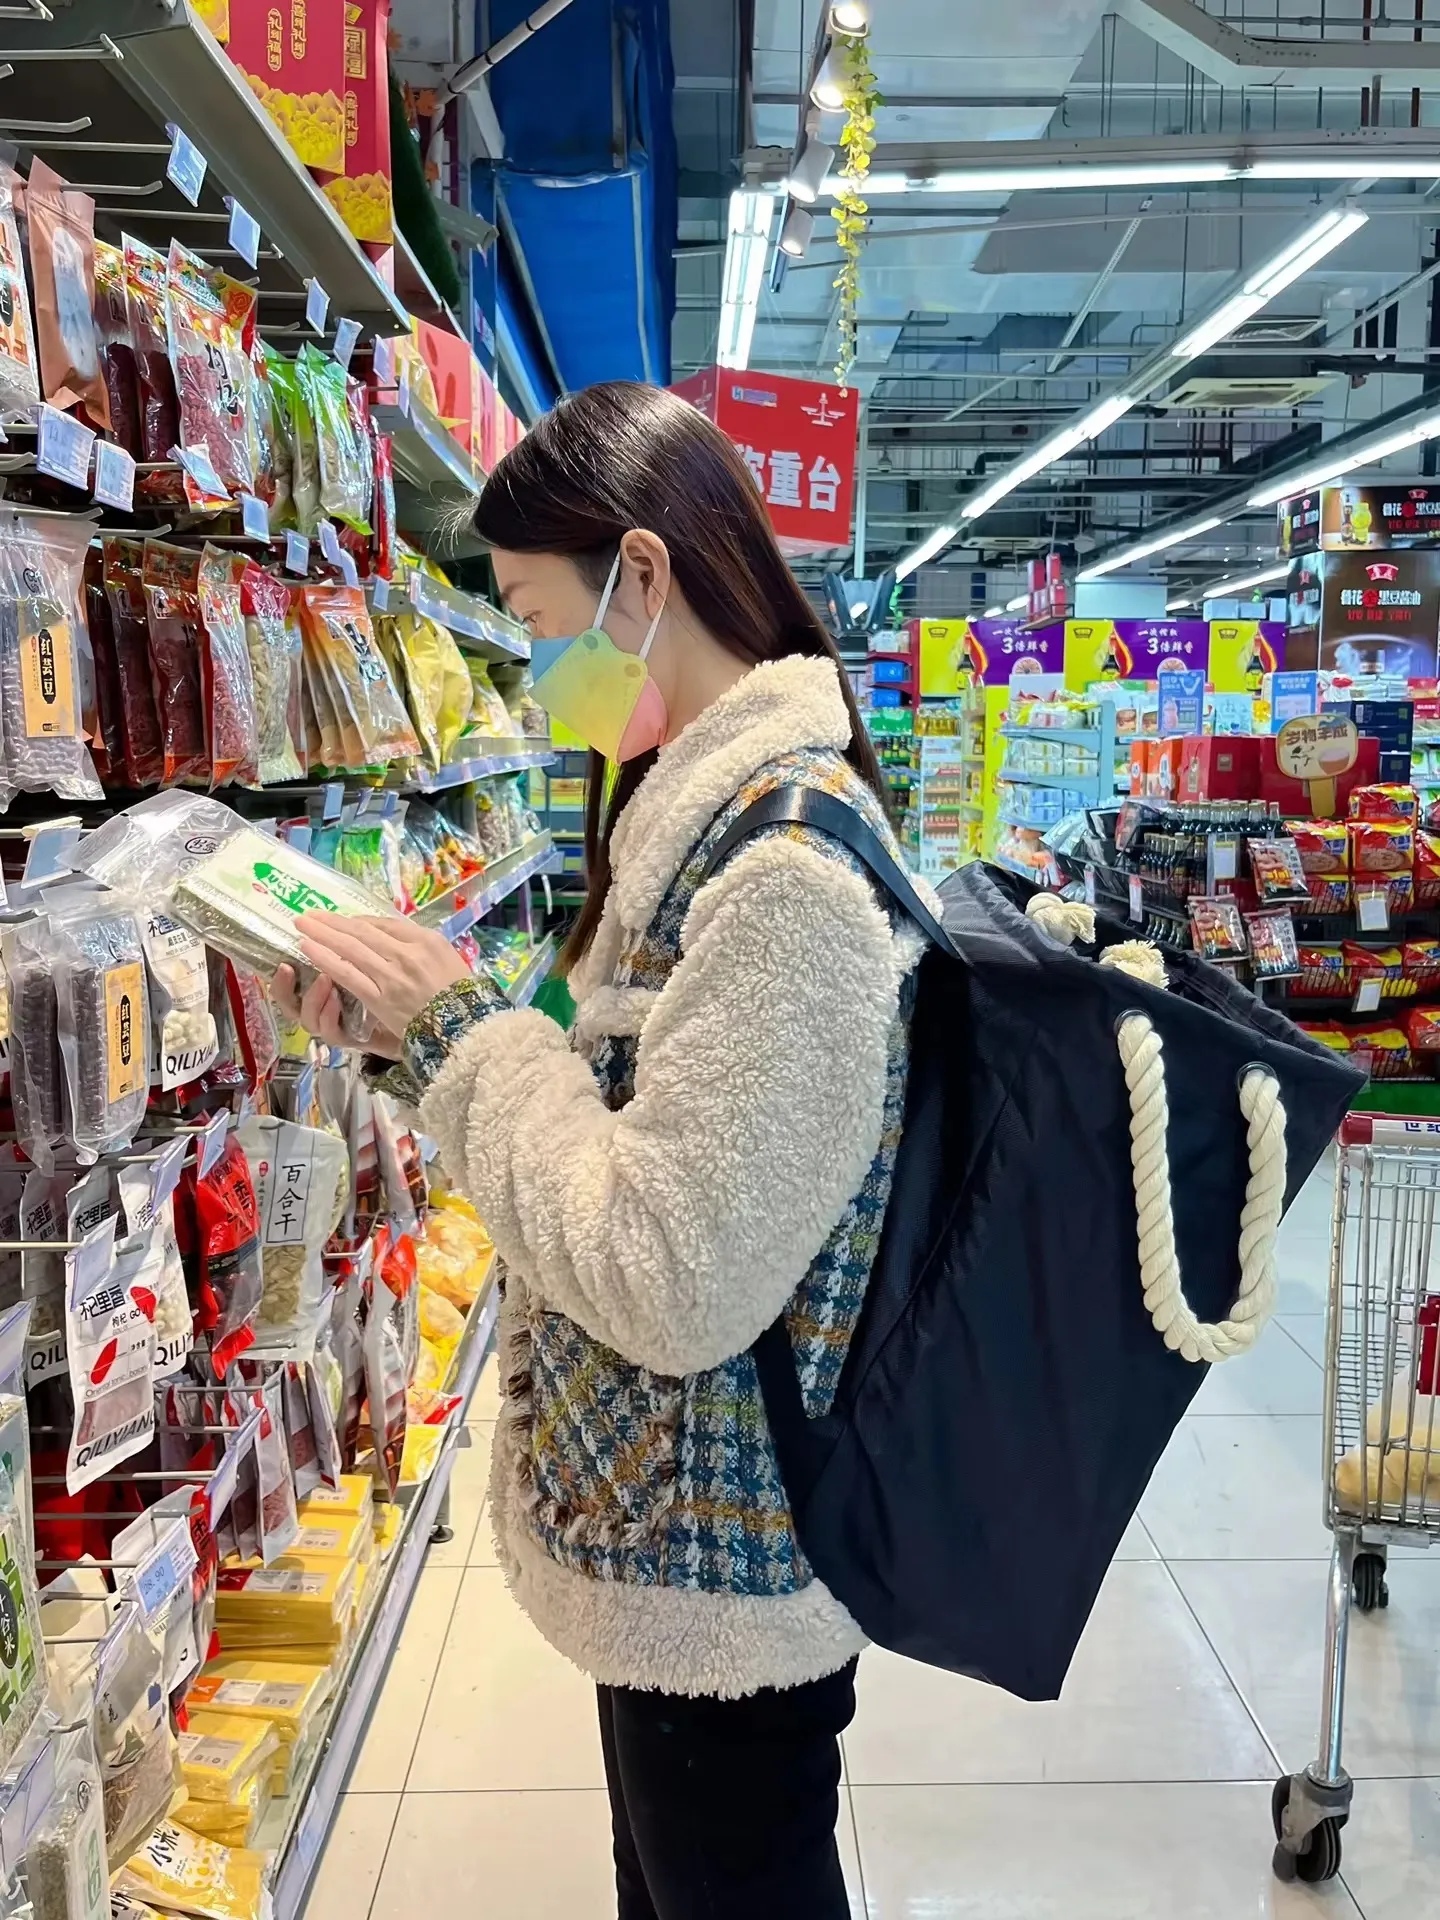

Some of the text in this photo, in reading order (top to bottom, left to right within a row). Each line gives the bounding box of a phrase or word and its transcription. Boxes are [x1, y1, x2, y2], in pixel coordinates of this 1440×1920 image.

[40, 638, 55, 696] 红芸豆
[148, 914, 182, 937] 杞里
[275, 1164, 306, 1235] 百合干
[80, 1284, 126, 1320] 杞里香
[147, 1827, 180, 1867] 小米
